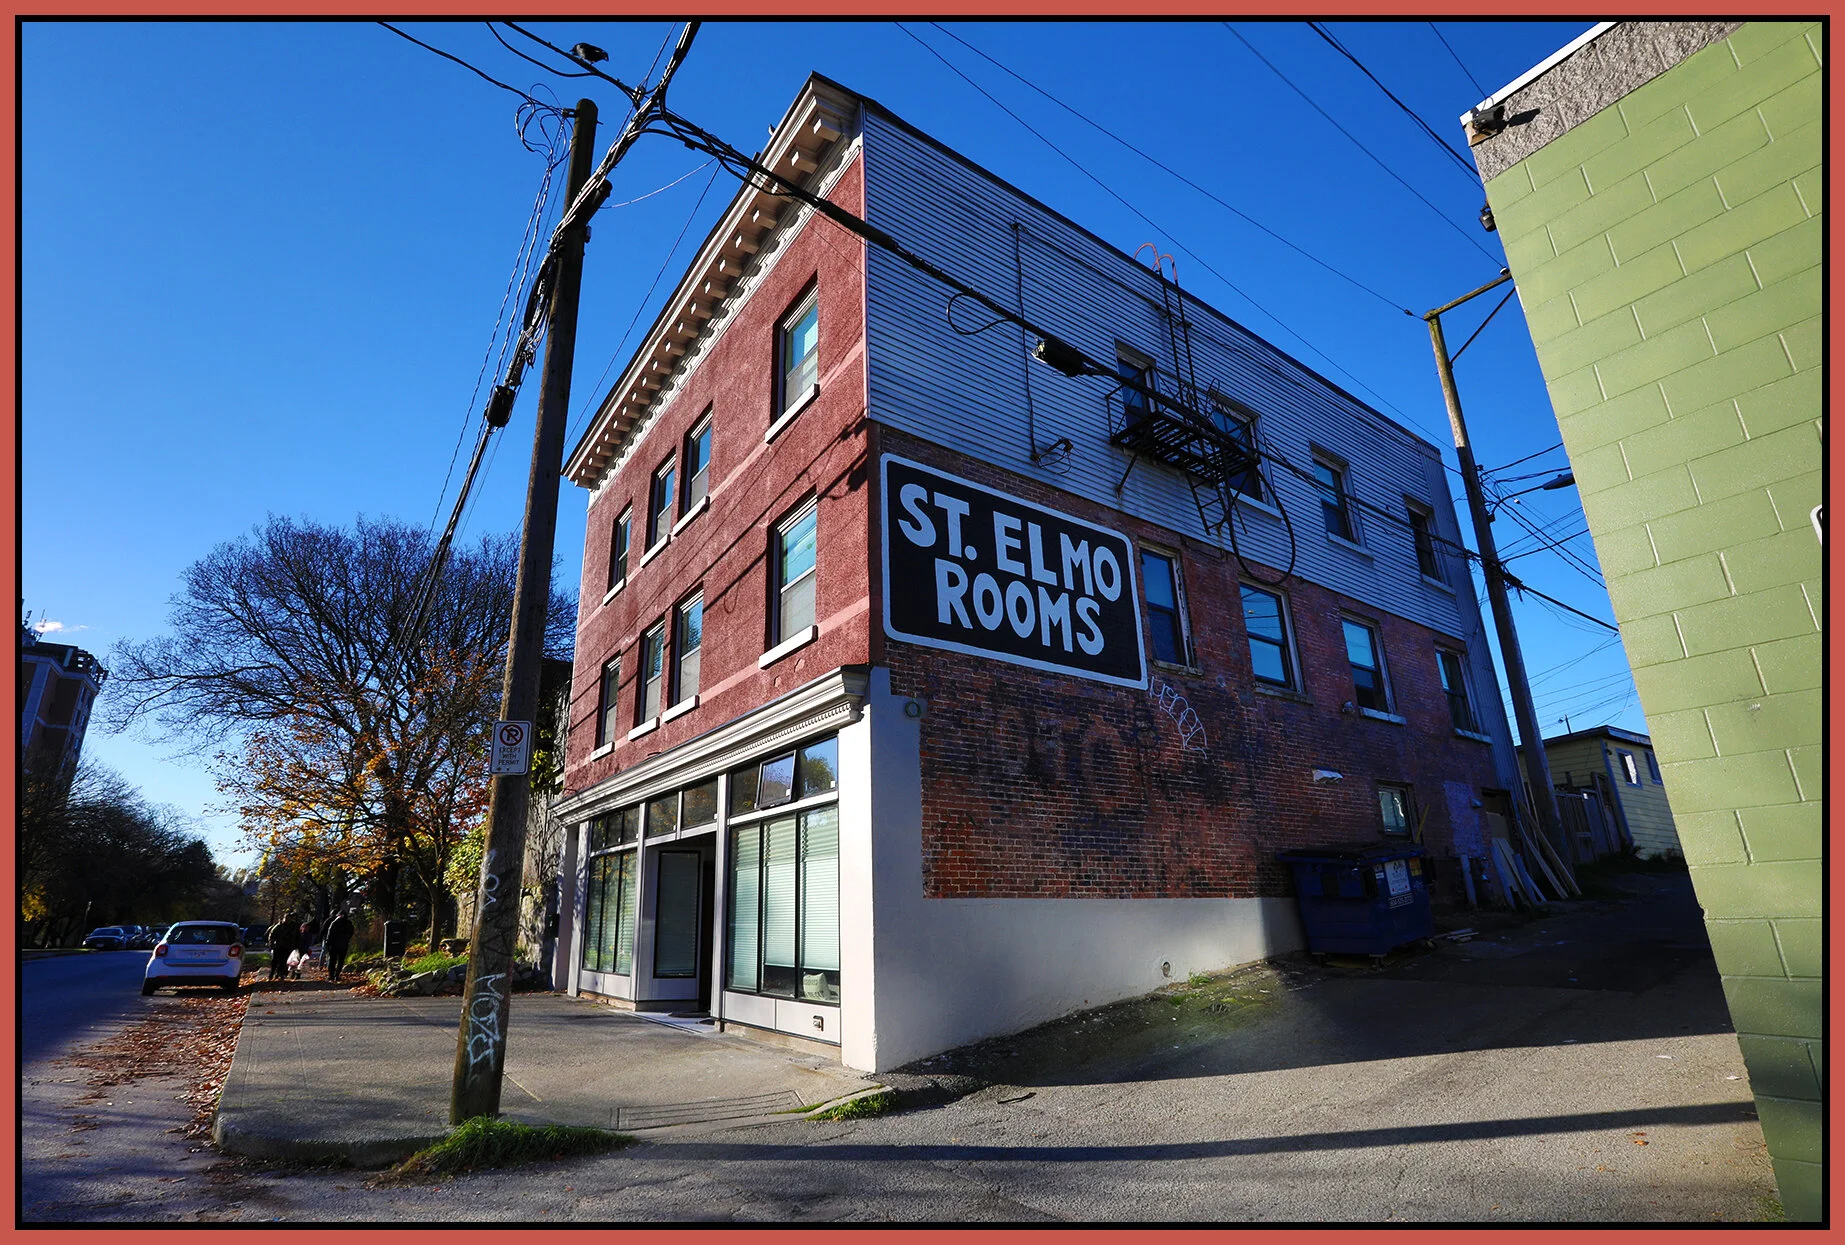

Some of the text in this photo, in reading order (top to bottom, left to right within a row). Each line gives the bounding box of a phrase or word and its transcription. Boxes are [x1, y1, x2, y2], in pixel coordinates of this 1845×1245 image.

[898, 483, 1122, 602] ST. ELMO
[935, 558, 1105, 656] ROOMS
